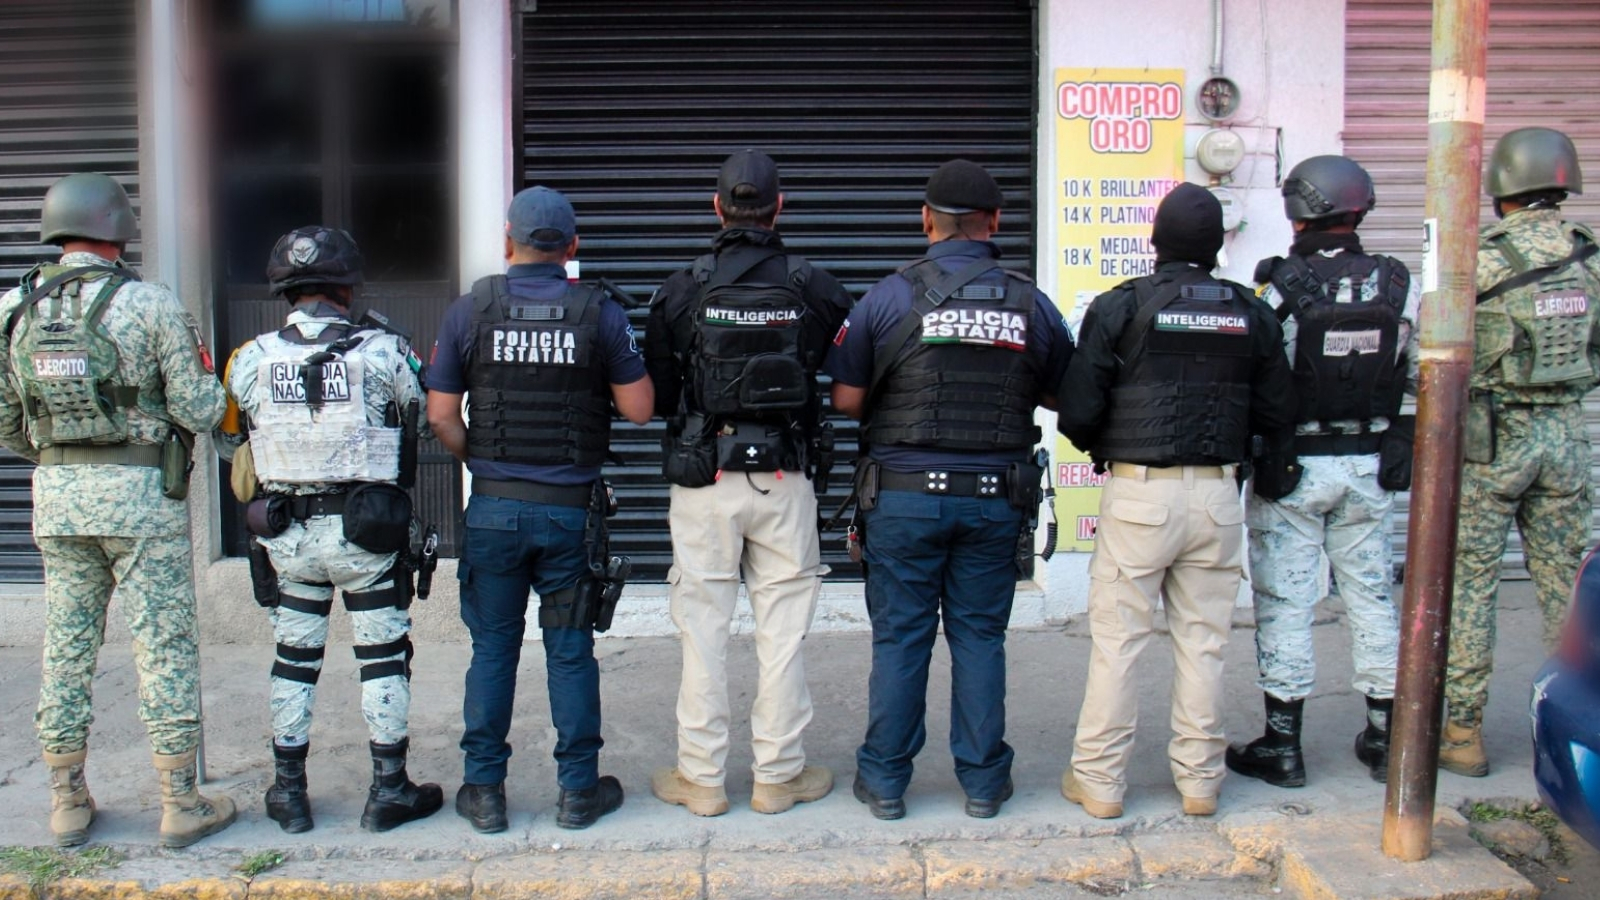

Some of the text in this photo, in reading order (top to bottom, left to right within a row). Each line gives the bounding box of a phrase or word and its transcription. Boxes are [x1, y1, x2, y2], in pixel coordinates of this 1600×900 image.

[1059, 82, 1182, 119] COMPRO
[1091, 119, 1150, 152] ORO
[1063, 179, 1078, 197] 10
[1083, 179, 1092, 197] K
[1063, 206, 1079, 224] 14
[1083, 206, 1092, 224] K
[1101, 237, 1156, 255] MEDALL
[1063, 248, 1092, 266] 18 K
[1101, 259, 1117, 276] DE
[706, 307, 797, 321] INTELIGENCIA
[1158, 313, 1246, 328] INTELIGENCIA
[922, 323, 1026, 345] ESTATAL
[493, 346, 576, 364] ESTATAL
